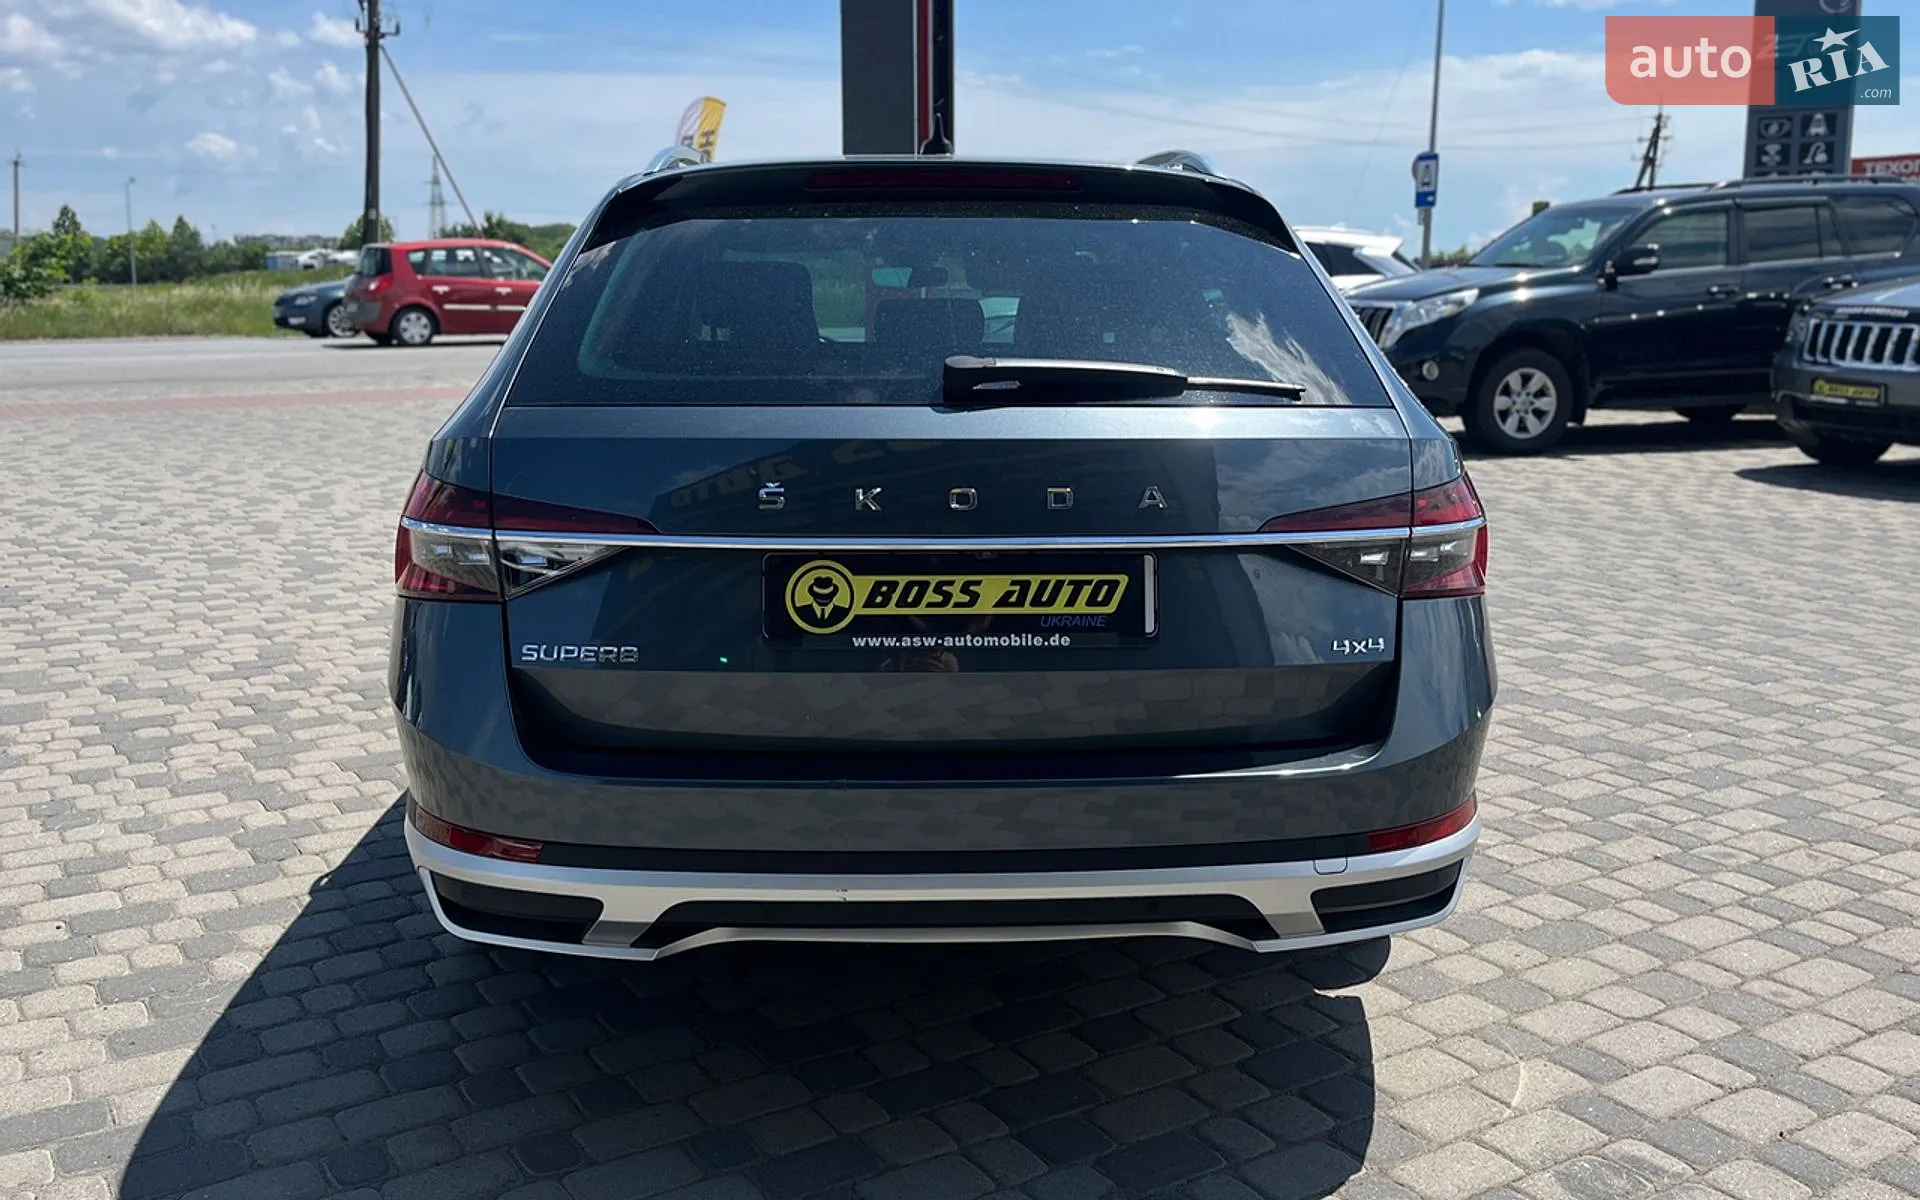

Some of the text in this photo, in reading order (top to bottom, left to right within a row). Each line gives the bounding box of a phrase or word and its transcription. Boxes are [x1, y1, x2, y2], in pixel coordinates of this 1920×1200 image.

[861, 579, 1121, 609] BOSS AUTO
[1040, 615, 1107, 628] UKRAINE
[852, 633, 1071, 648] www.asw-automobile.de
[521, 644, 639, 662] SUPERB
